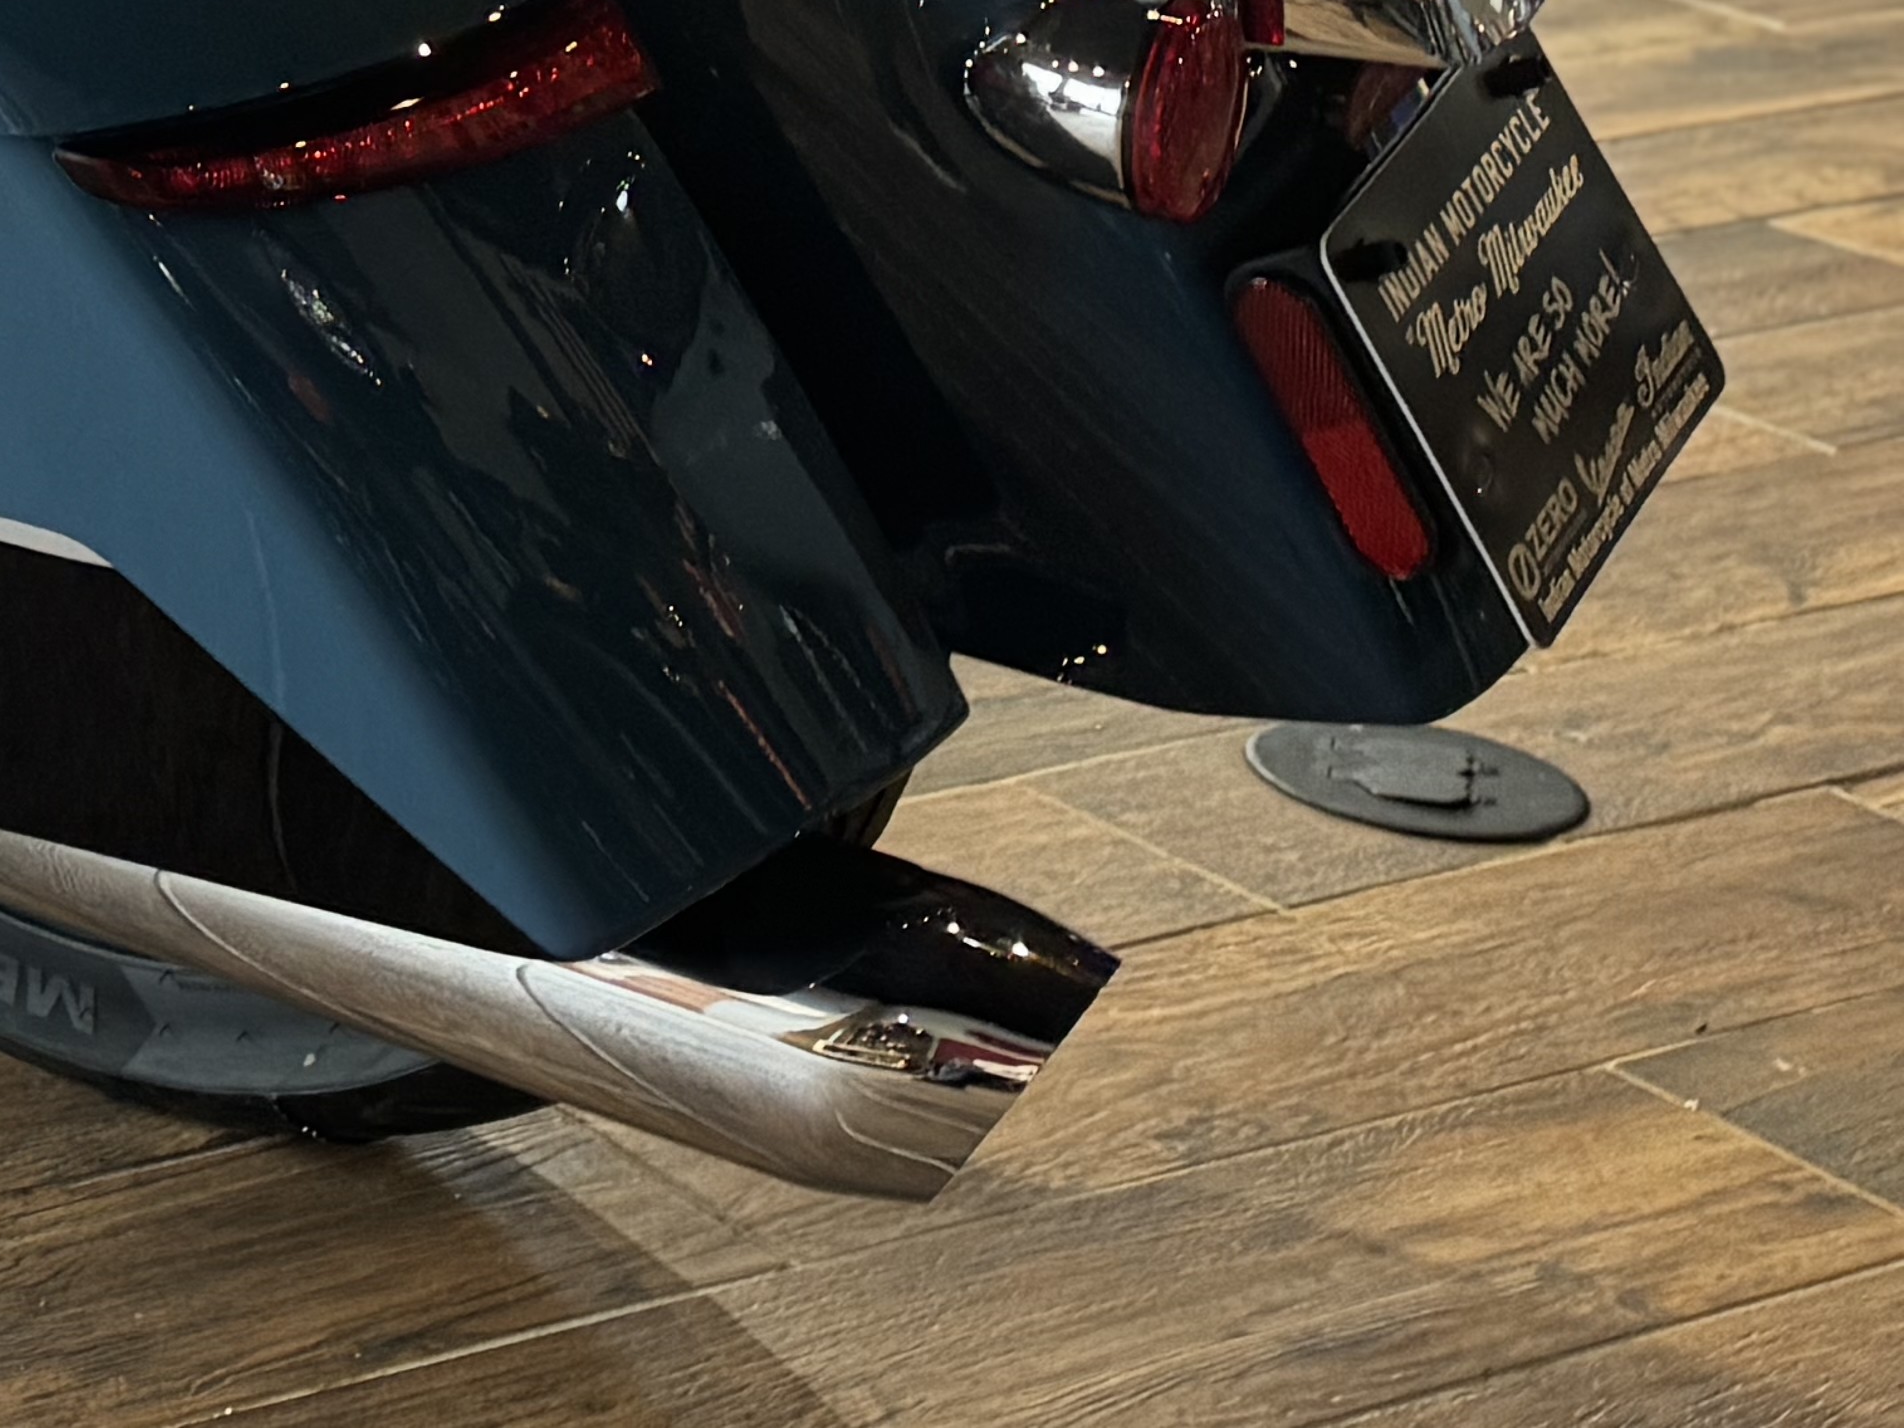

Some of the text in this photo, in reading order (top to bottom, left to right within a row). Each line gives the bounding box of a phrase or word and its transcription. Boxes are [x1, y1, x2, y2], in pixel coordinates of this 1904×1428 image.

[1378, 87, 1551, 324] INDIAN MOTORCYCLE
[1415, 153, 1585, 380] Metro Milwaukee
[1476, 275, 1574, 434] WE ARE SO
[1530, 350, 1587, 444] MUCH
[1525, 476, 1579, 562] ZERO
